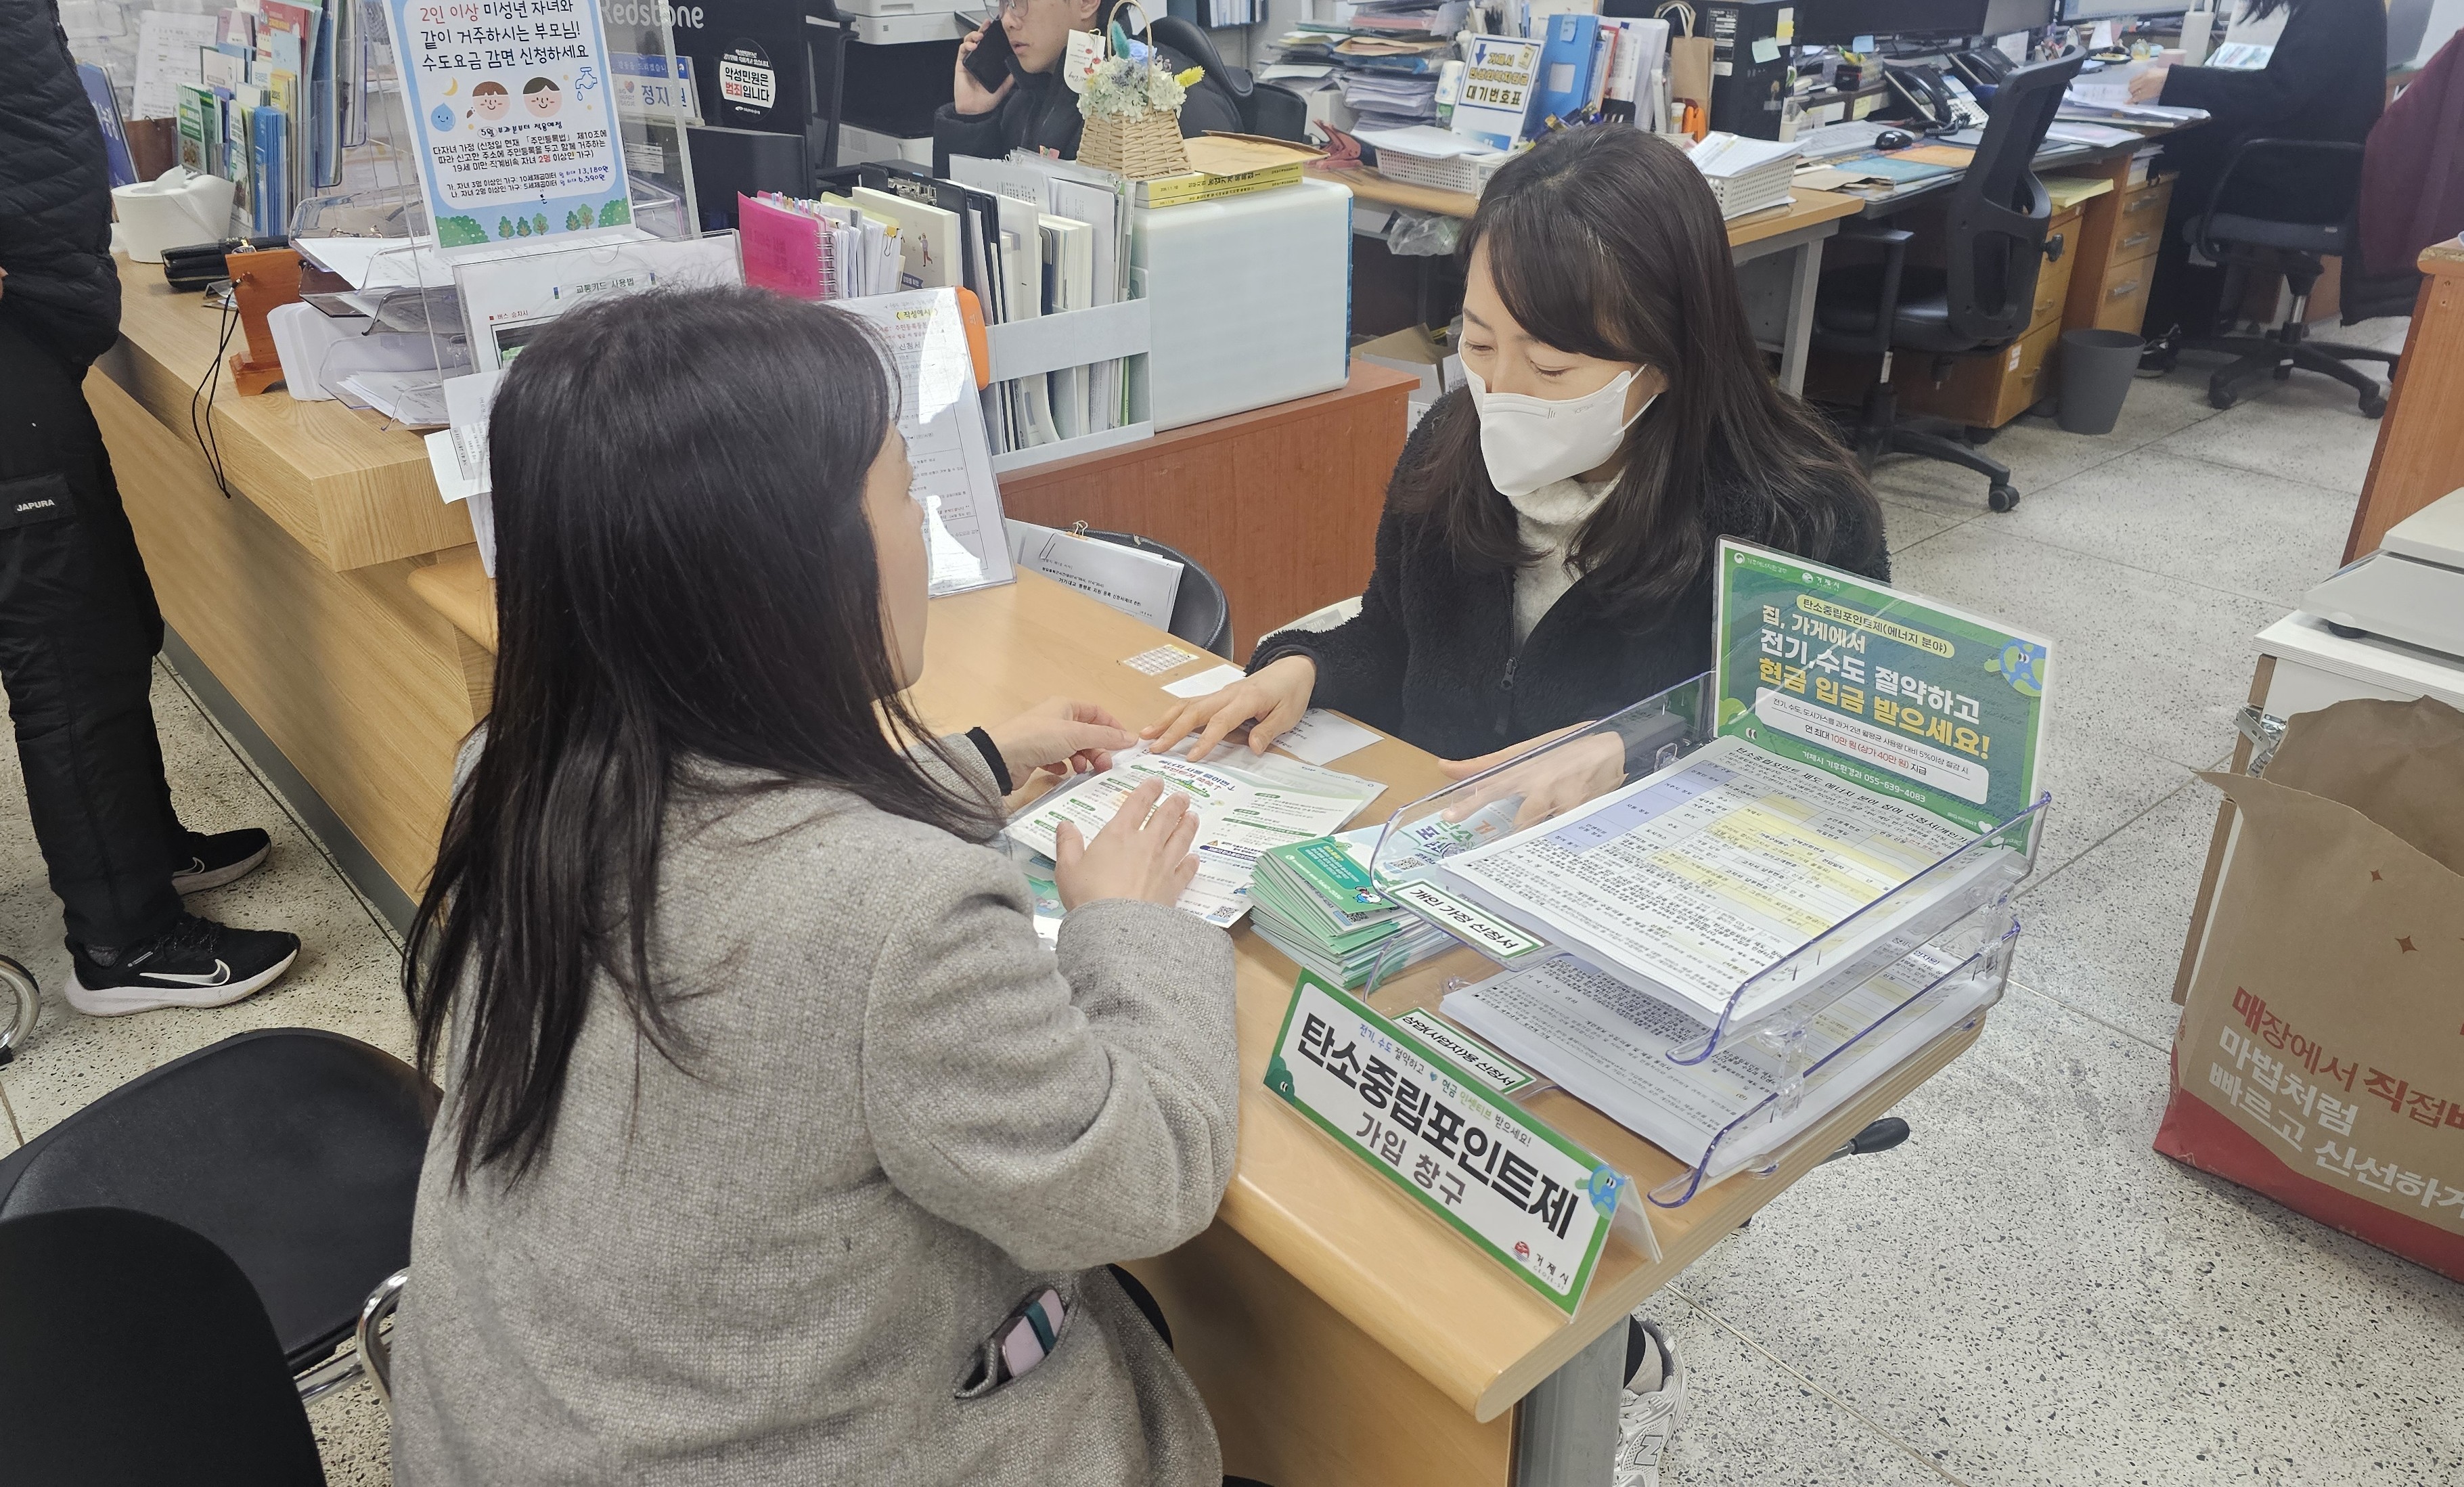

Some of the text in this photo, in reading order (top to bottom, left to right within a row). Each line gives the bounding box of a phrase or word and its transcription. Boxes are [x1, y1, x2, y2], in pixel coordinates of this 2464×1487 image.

[420, 0, 573, 24] 2인 이상 미성년 자녀와
[421, 21, 581, 49] 같이 거주하시는 부모님!
[422, 45, 589, 72] 수도요금 감면 신청하세요
[725, 66, 769, 87] 악성민원은
[641, 85, 688, 108] 정지
[725, 82, 770, 102] 범죄입니다
[1466, 85, 1522, 106] 대기번호표
[433, 146, 457, 155] 다자녀
[460, 143, 475, 153] 가정
[504, 139, 520, 148] 현재
[577, 129, 608, 139] 제10조에
[480, 128, 495, 137] 5월
[534, 121, 562, 131] 적용예정
[439, 156, 455, 164] 따라
[483, 150, 505, 160] 주소에
[507, 147, 542, 157] 주민등록을
[544, 144, 560, 154] 두고
[578, 139, 606, 150] 거주하는
[452, 150, 595, 173] 19세 미만 직계비속 자녀 2명 이상인 가구)
[457, 182, 470, 190] 자녀
[471, 181, 483, 189] 3명
[484, 178, 502, 187] 이상인
[461, 190, 474, 198] 자녀
[475, 187, 487, 196] 2명
[487, 185, 507, 194] 이상인
[575, 277, 635, 293] 교통카드 사용법
[511, 309, 529, 319] 승차시
[903, 308, 931, 319] 작성예시
[899, 342, 922, 351] 신청서
[17, 499, 55, 512] JAPURA
[1058, 577, 1077, 587] 거가대교
[1762, 604, 1866, 654] 집, 가게에서
[1803, 598, 1948, 656] 탄소중립포인트제(에너지 분야)
[1873, 665, 1980, 726] 절약하고
[1759, 657, 1992, 761] 현금 입금 받으세요!
[1804, 724, 1928, 776] 연 최대 10만 원 (상가 40만 원) 지급
[1835, 719, 1849, 732] 과거
[1849, 725, 1862, 736] 2년
[1862, 729, 1882, 742] 월평균
[1883, 736, 1904, 750] 사용량
[1904, 744, 1919, 755] 대비
[1919, 749, 1945, 765] 5%이상
[1946, 759, 1961, 771] 절감
[1961, 765, 1969, 776] 시
[1802, 750, 1825, 766] 거제시
[1863, 773, 1927, 803] 055-639-4083
[1803, 772, 1823, 782] 제도
[1825, 782, 1855, 797] 에너지
[1410, 889, 1519, 950] 개인 가정 신청서
[2232, 985, 2360, 1093] 매장에서
[1359, 1022, 1533, 1149] 전기, 수도 절약하고 현금 인센티브 받으세요!
[1475, 1061, 1517, 1087] 신청서
[2218, 1024, 2360, 1138] 마법처럼
[2208, 1061, 2307, 1153] 빠르고
[1297, 1012, 1580, 1241] 탄소중립포인트제
[1356, 1111, 1467, 1206] 가입 창구
